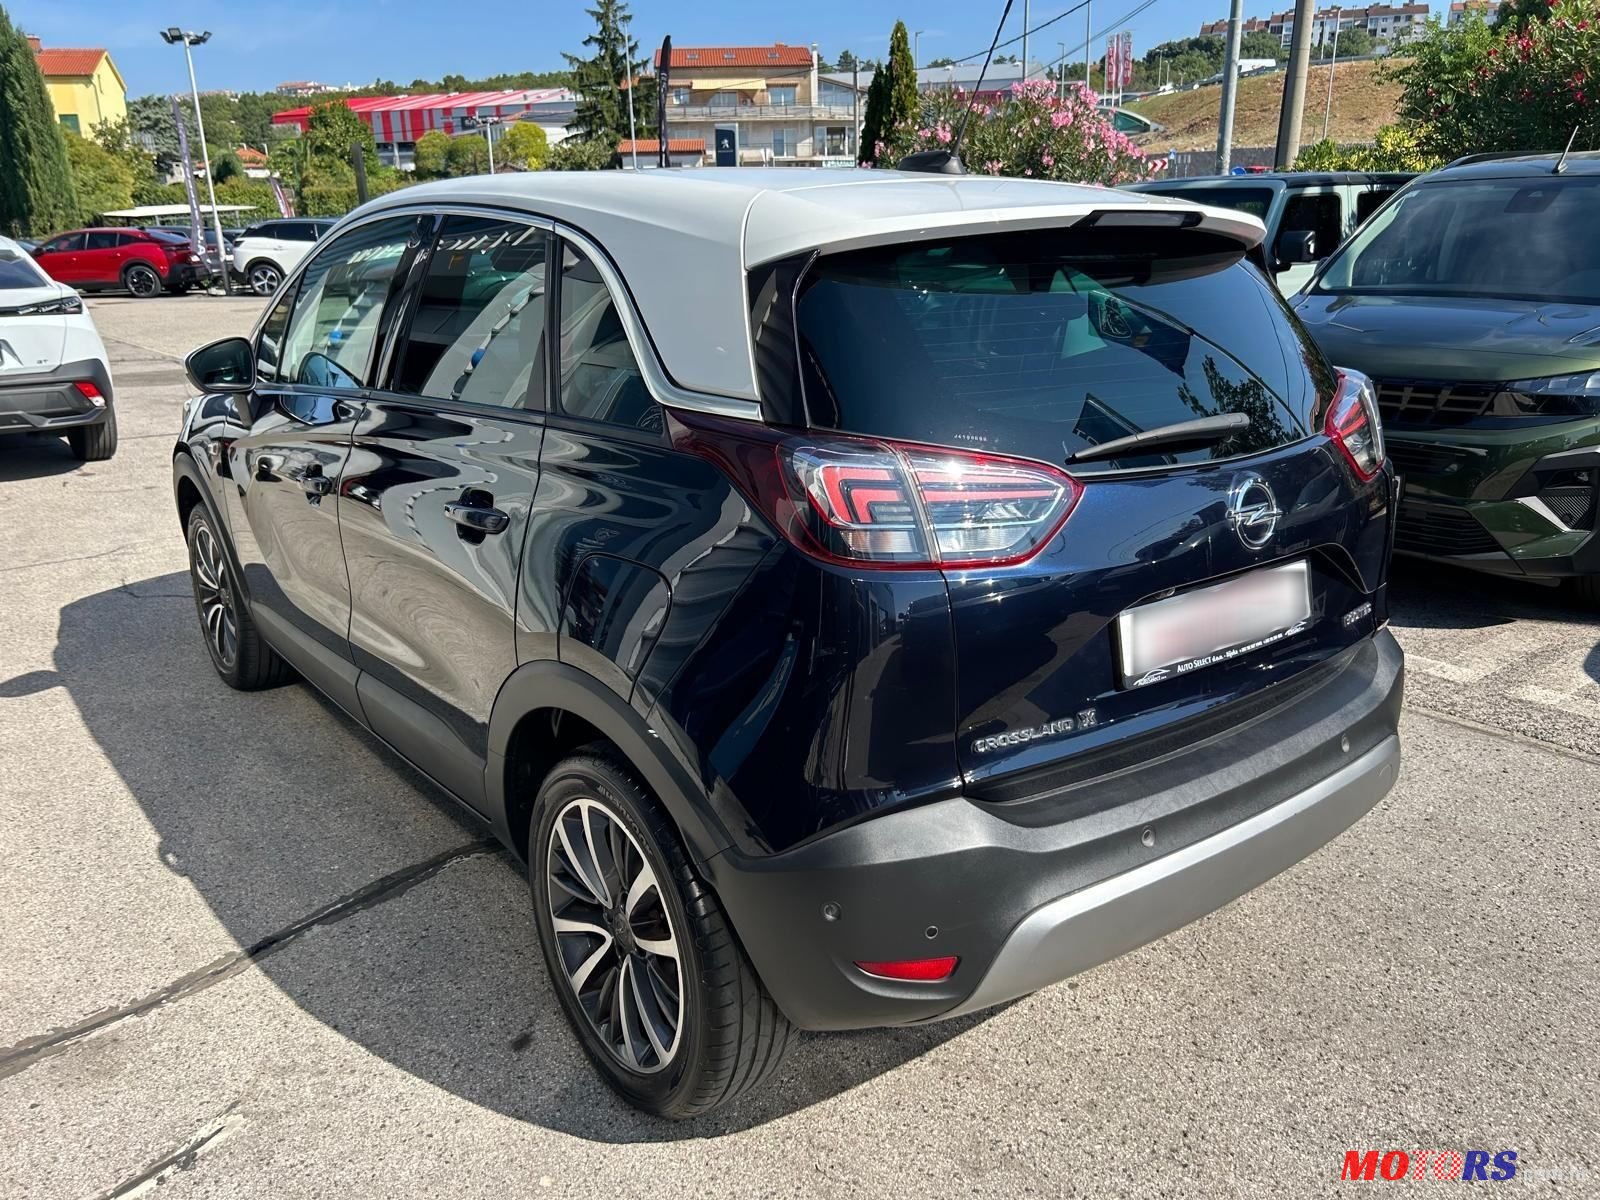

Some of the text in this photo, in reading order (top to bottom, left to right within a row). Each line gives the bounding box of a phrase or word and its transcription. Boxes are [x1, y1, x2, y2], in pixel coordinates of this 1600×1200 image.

[1177, 662, 1194, 673] AUTO
[1193, 656, 1212, 669] SELECT
[971, 708, 1097, 753] CROSSLAND X
